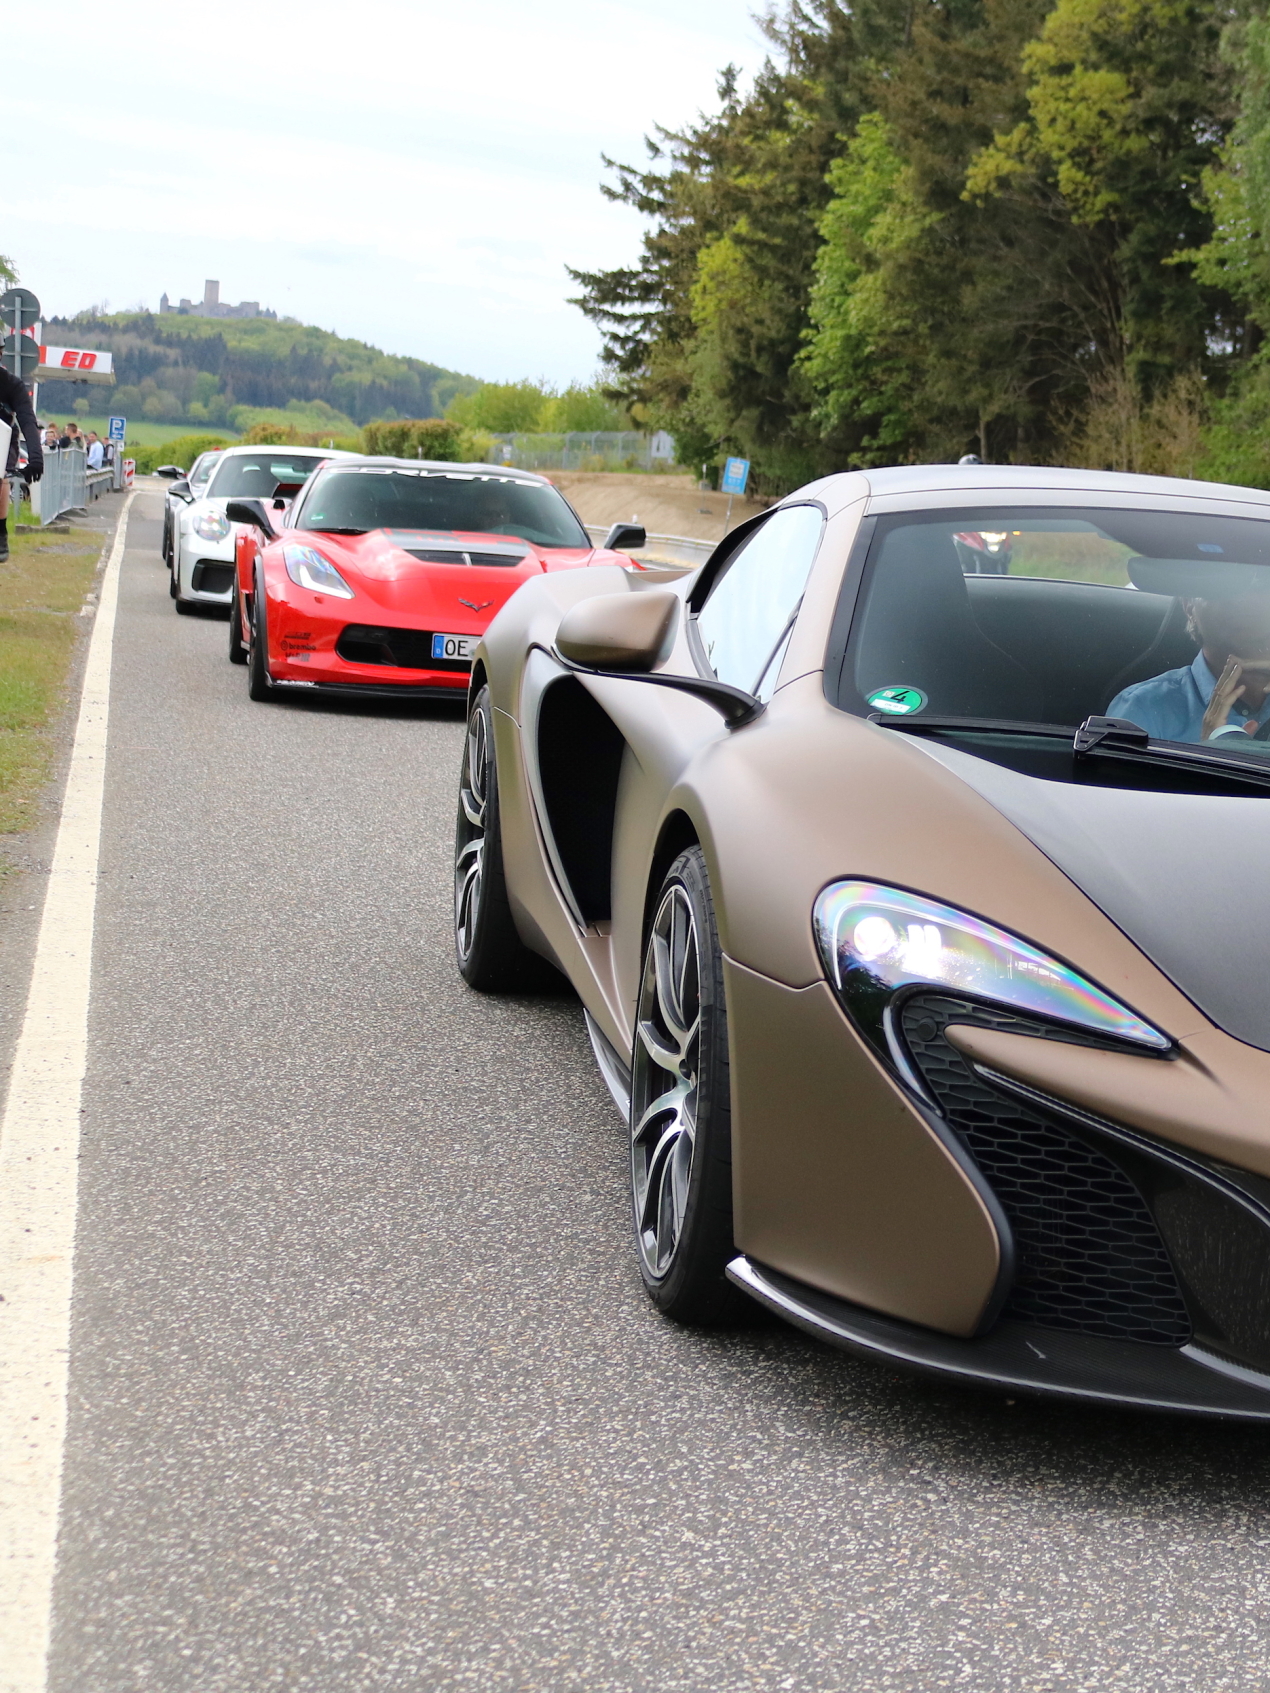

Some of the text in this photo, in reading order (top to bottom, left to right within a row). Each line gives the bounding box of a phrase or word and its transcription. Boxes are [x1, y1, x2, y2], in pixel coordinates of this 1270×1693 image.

[112, 420, 122, 432] P
[445, 639, 469, 657] OE
[890, 690, 910, 703] 4
